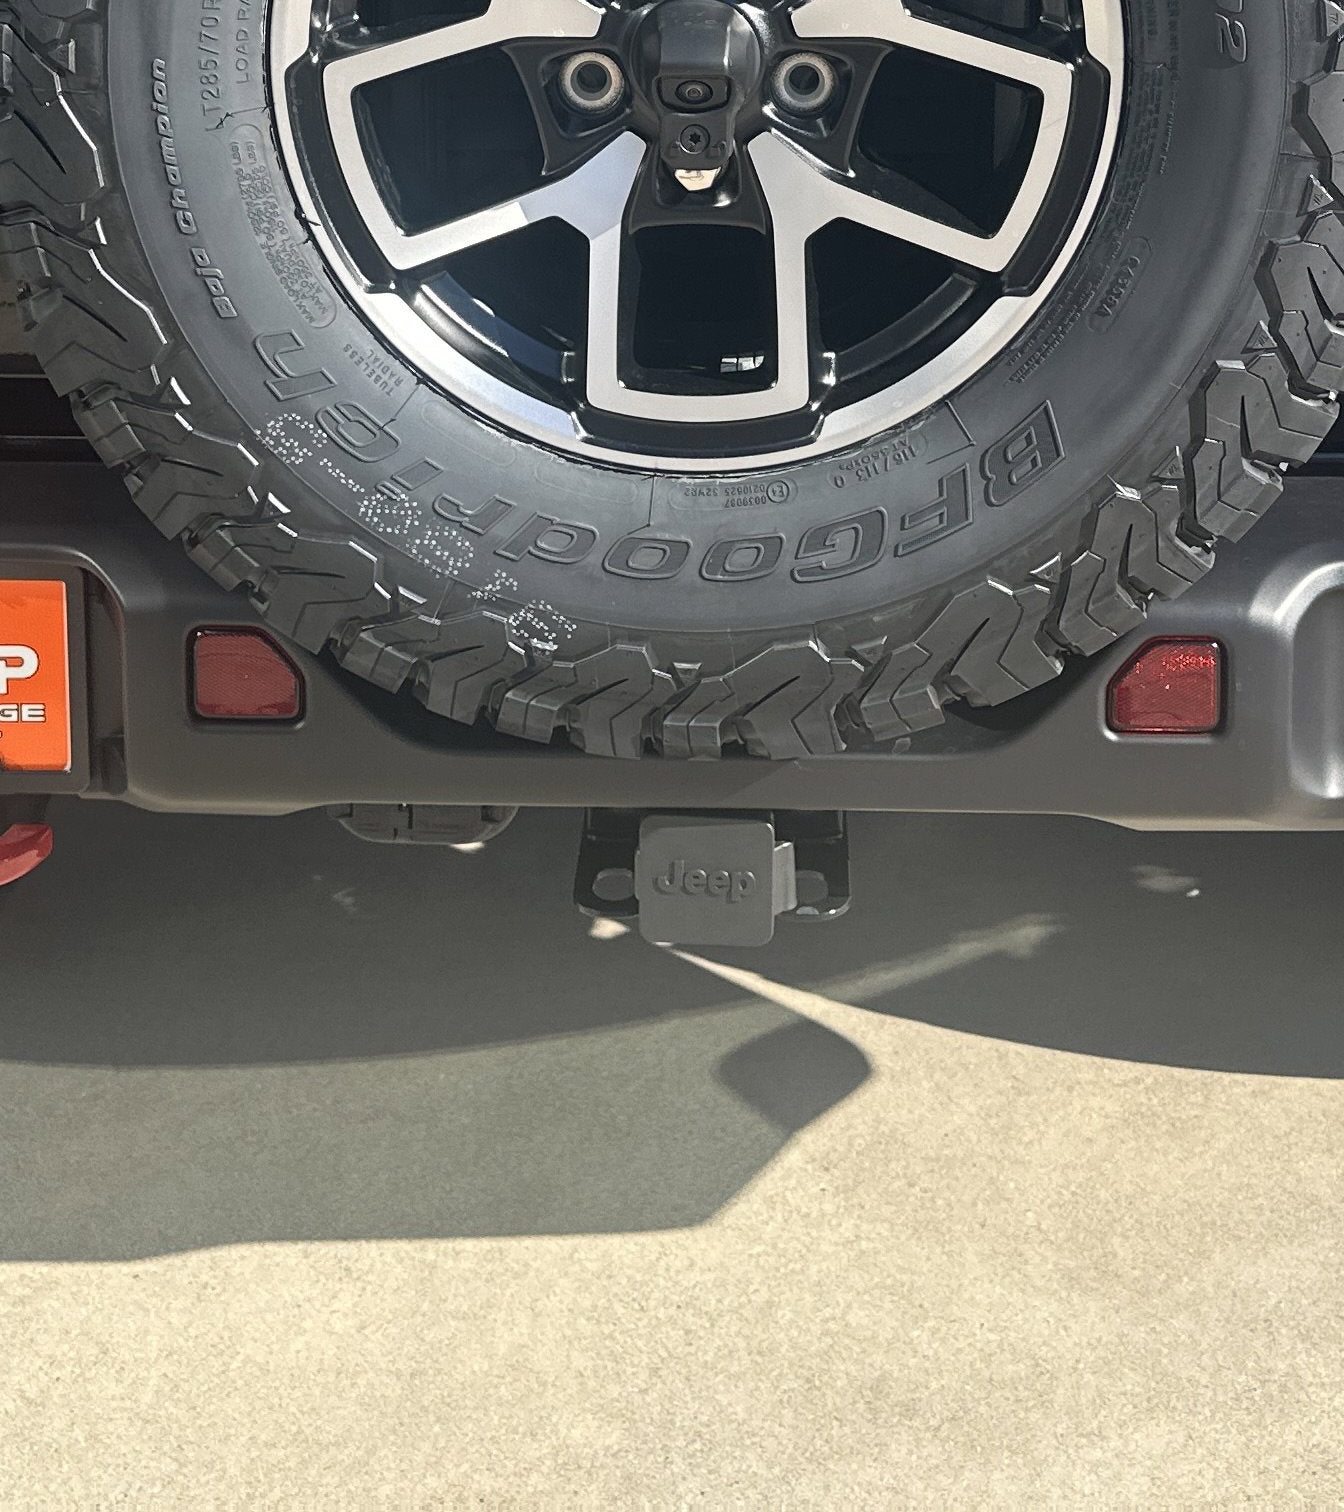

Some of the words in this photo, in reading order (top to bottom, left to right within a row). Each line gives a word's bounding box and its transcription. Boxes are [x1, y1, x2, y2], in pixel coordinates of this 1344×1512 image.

[235, 28, 251, 85] LOAD
[151, 57, 199, 236] Champion
[189, 246, 239, 319] Baja
[341, 341, 396, 397] TUBELESS
[364, 347, 404, 387] RADIAL
[253, 328, 1066, 584] BFGoodrich
[653, 859, 756, 905] Jeep
